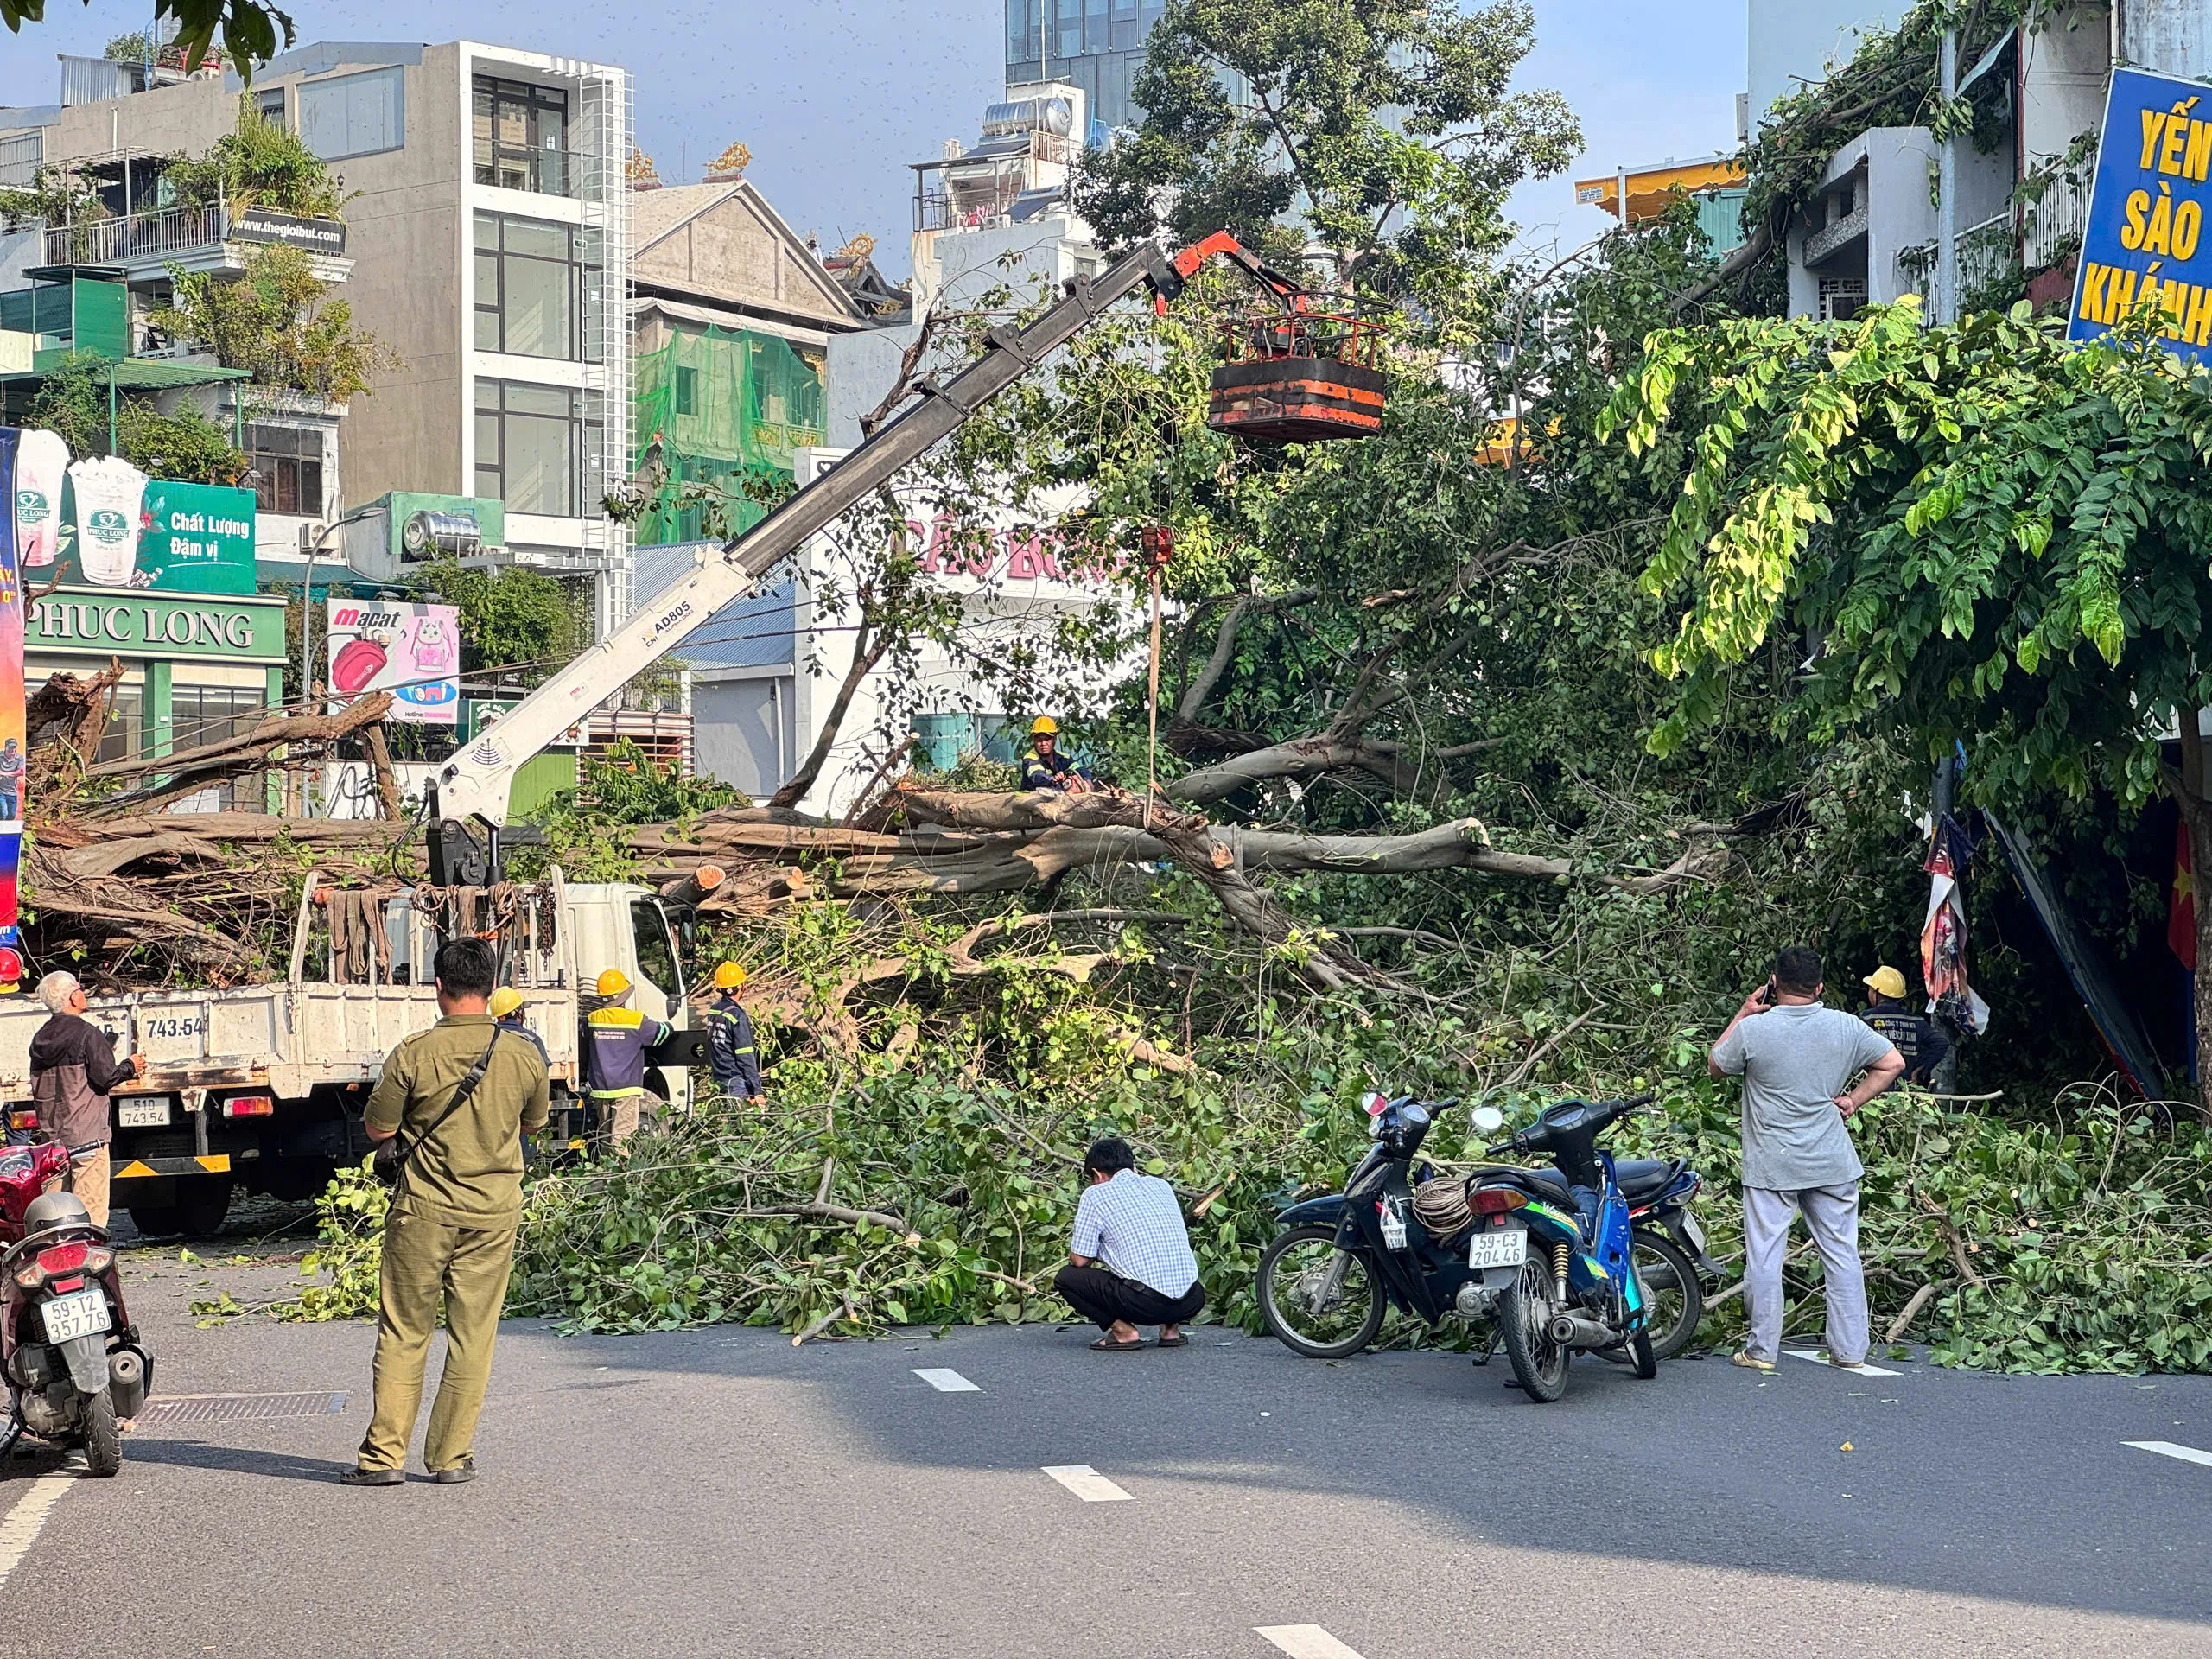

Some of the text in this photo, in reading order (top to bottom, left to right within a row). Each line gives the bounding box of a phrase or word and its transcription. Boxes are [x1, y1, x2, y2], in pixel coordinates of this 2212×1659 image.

[2139, 96, 2212, 181] YẾN
[2120, 181, 2202, 261] SÀO
[171, 512, 249, 540] Chất Lượng
[170, 537, 219, 562] Đậm vị
[143, 607, 255, 648] LONG
[333, 608, 401, 628] macat
[654, 601, 690, 634] AD805
[146, 1017, 204, 1039] 743.54
[125, 1111, 164, 1124] 743.54
[133, 1099, 155, 1112] 51D
[1479, 1233, 1518, 1250] 59-C3
[1474, 1248, 1521, 1266] 204.46
[52, 1294, 97, 1319] 59-T2
[50, 1311, 106, 1340] 357.76
